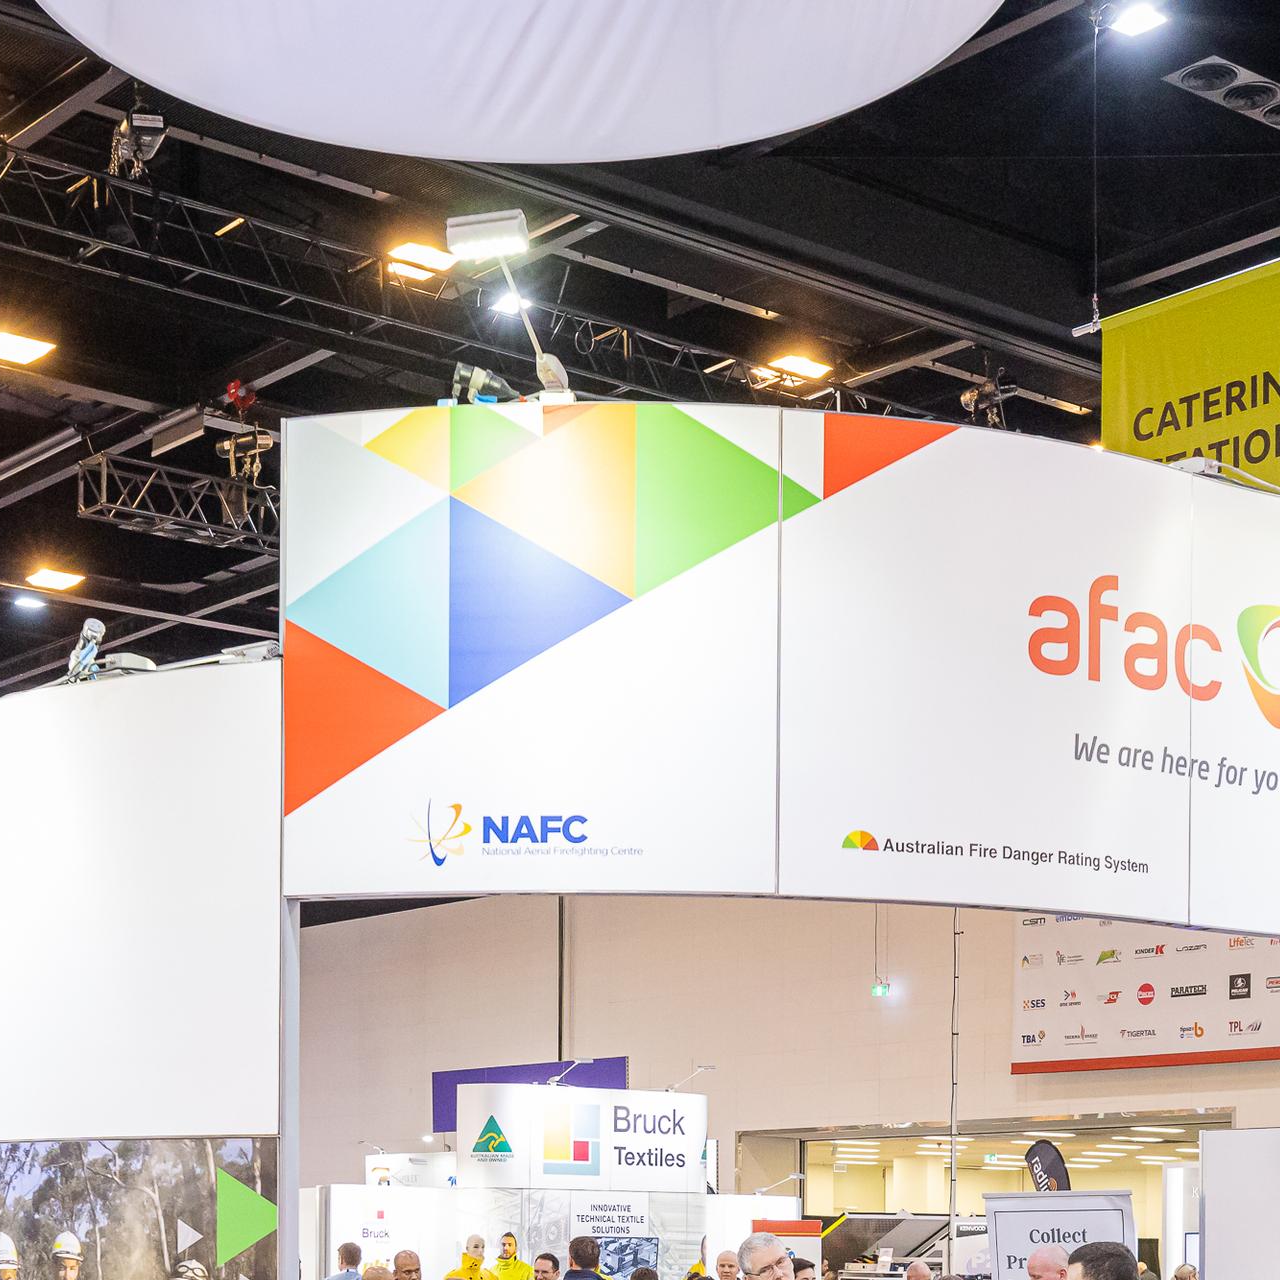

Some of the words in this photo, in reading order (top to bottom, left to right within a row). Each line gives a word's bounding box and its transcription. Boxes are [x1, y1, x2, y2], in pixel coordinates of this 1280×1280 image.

[1028, 575, 1222, 701] afac
[1074, 733, 1110, 764] We
[1118, 746, 1154, 770] are
[1161, 747, 1210, 780] here
[1214, 757, 1248, 788] for
[483, 815, 588, 843] NAFC
[482, 846, 521, 856] National
[523, 846, 551, 856] Aerial
[611, 847, 644, 856] Centre
[883, 838, 963, 856] Australian
[969, 843, 997, 859] Fire
[1002, 846, 1053, 865] Danger
[1058, 850, 1101, 871] Rating
[1104, 855, 1149, 874] System
[1171, 985, 1207, 995] PARATECH
[1031, 999, 1045, 1008] SES
[1229, 1021, 1243, 1032] TPL
[1022, 1035, 1036, 1043] TBA
[613, 1105, 685, 1135] Bruck
[613, 1146, 685, 1167] Textiles
[590, 1204, 631, 1212] INNOVATIVE
[576, 1215, 616, 1223] TECHNICAL
[362, 1228, 390, 1238] Bruck
[592, 1226, 631, 1234] SOLUTIONS
[1029, 1228, 1088, 1244] Collect
